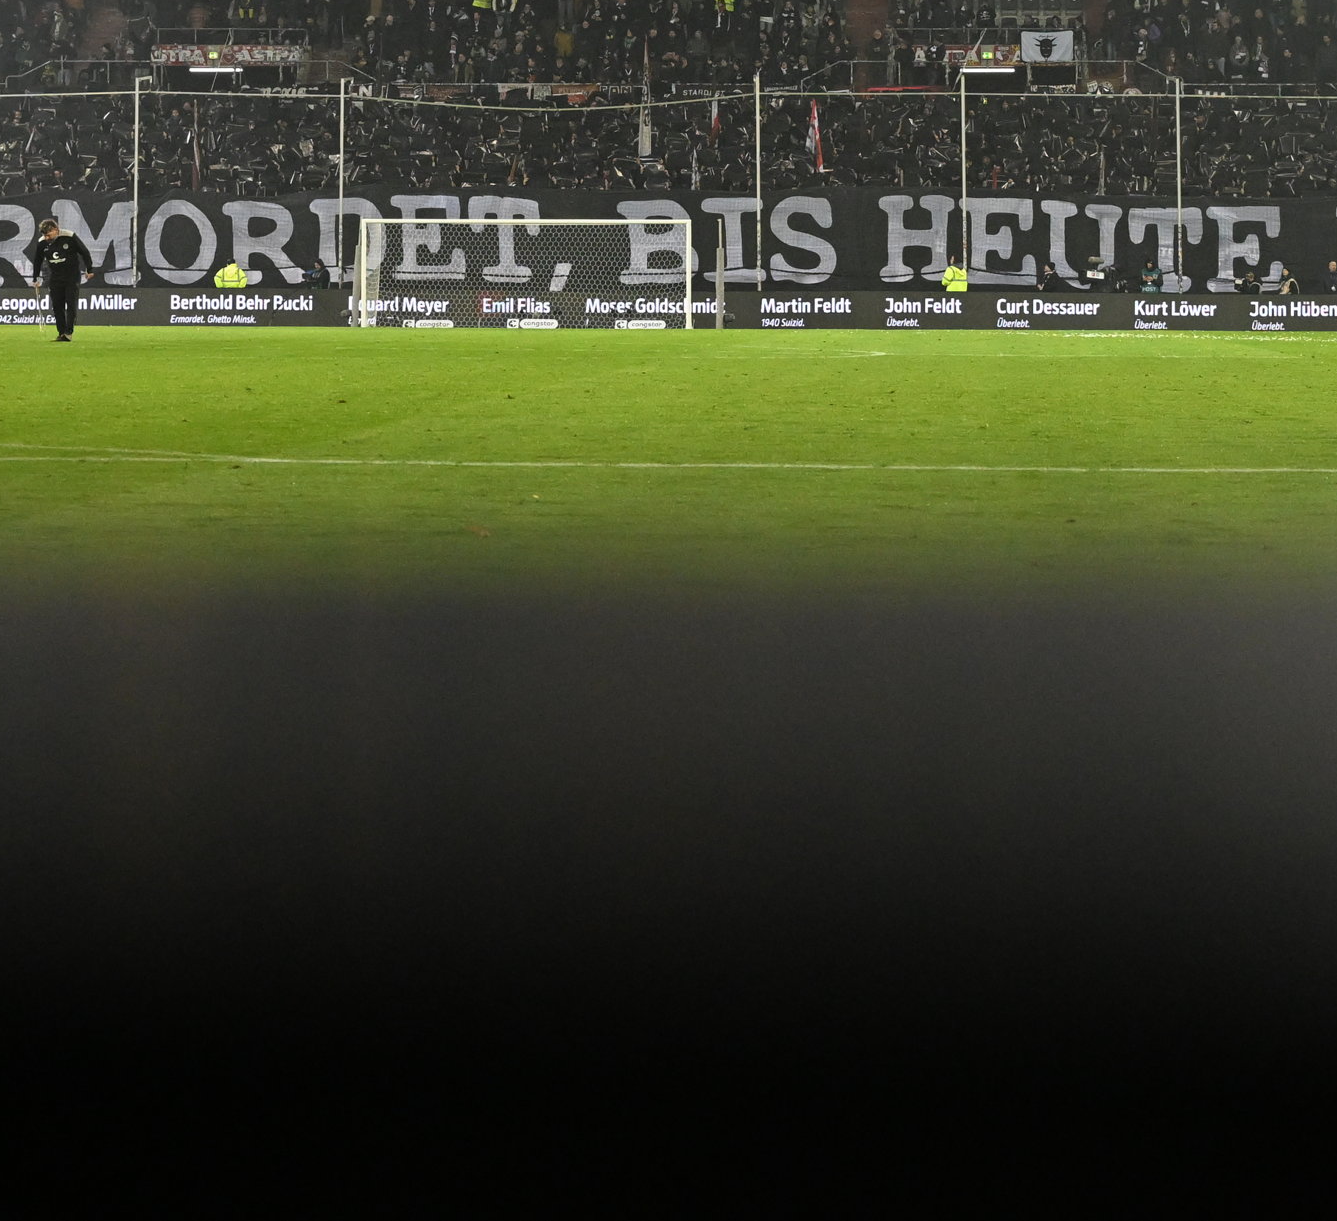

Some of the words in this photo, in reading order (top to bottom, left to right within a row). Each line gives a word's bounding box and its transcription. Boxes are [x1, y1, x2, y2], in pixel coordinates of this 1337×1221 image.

[617, 196, 838, 285] BIS
[879, 195, 1282, 293] HEUTE
[90, 295, 137, 310] Müller
[171, 294, 232, 310] Berthold
[236, 295, 270, 310] Behr
[402, 297, 450, 316] Meyer
[483, 298, 516, 313] Emil
[761, 298, 810, 313] Martin
[815, 298, 851, 313] Feldt
[885, 298, 921, 313] John
[925, 298, 961, 313] Feldt
[997, 299, 1029, 314] Curt
[1033, 299, 1100, 315] Dessauer
[1135, 301, 1168, 316] Kurt
[1172, 301, 1217, 316] Löwer
[1250, 301, 1286, 316] John
[13, 315, 34, 323] Suizid
[170, 315, 205, 323] Ermordet.
[208, 315, 231, 323] Ghetto
[233, 315, 256, 323] Minsk.
[523, 321, 555, 329] congstar
[631, 321, 663, 329] congstar
[762, 318, 780, 326] 1940
[781, 318, 804, 326] Suizid.
[887, 319, 919, 328] Überlebt.
[997, 320, 1030, 329] Überlebt.
[1135, 319, 1167, 329] Überlebt.
[1252, 320, 1284, 330] Überlebt.
